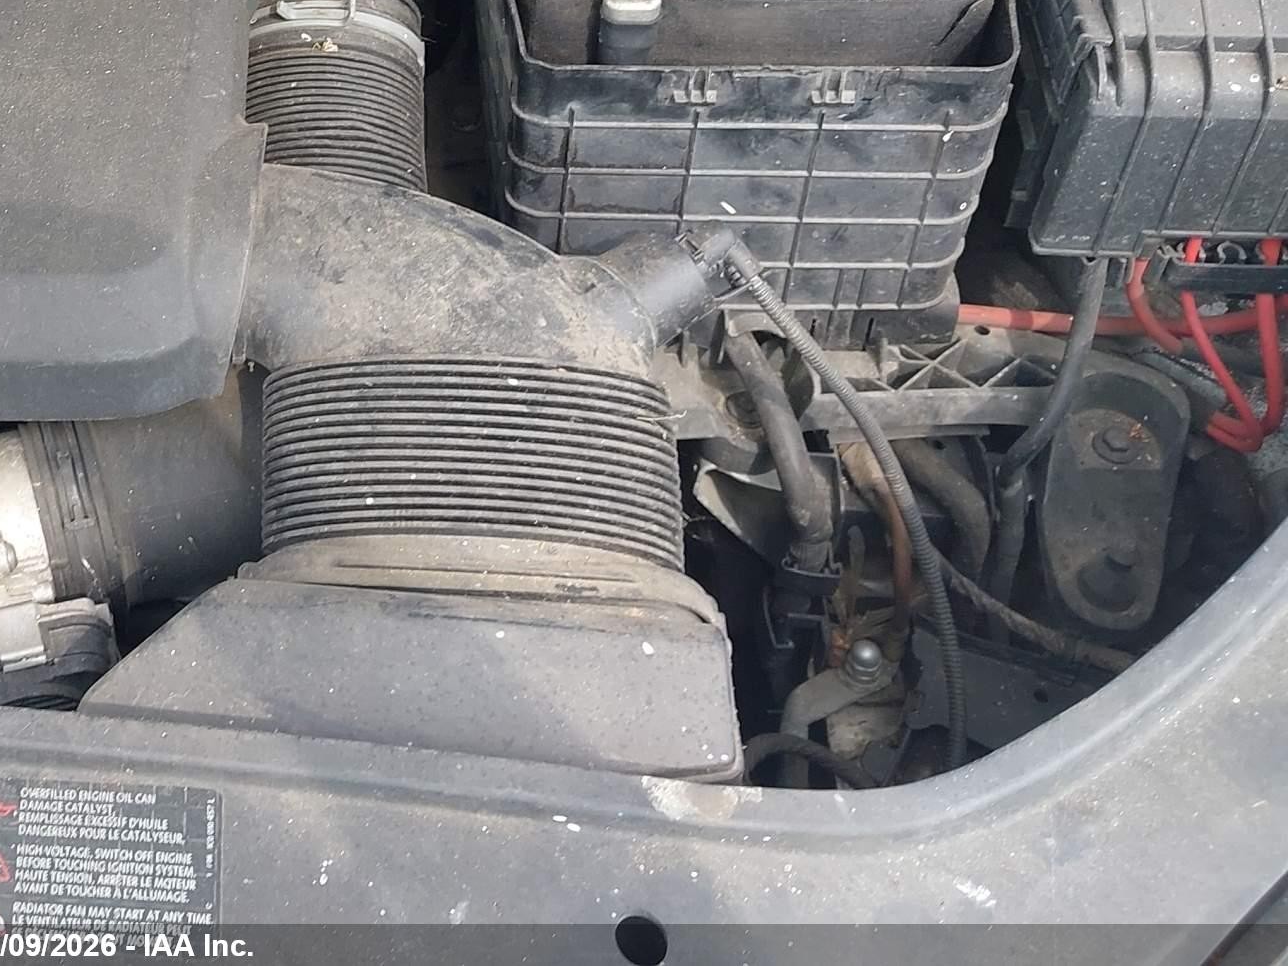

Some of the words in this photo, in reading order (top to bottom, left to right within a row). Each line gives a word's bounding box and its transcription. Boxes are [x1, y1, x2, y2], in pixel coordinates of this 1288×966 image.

[20, 787, 77, 800] OVERFILLED
[78, 790, 114, 803] ENGINE
[116, 792, 133, 804] OIL
[134, 792, 156, 805] CAN
[19, 799, 64, 812] DAMAGE
[18, 811, 83, 826] REMPLISSAGE
[84, 814, 128, 828] EXCESSIF
[17, 824, 78, 838] DANGEREUX
[79, 827, 107, 840] POUR
[108, 829, 121, 841] LE
[16, 843, 43, 857] HIGH
[94, 848, 133, 861] SWITCH
[134, 850, 154, 862] OFF
[155, 851, 192, 865] ENGINE
[16, 856, 52, 869] BEFORE
[53, 858, 106, 873] TOUCHING
[107, 861, 154, 875] IGNITION
[14, 869, 50, 882] HAUTE
[140, 876, 153, 888] LE
[154, 877, 197, 891] MOTEUR
[14, 881, 49, 894] AVANT
[50, 884, 64, 896] DE
[66, 885, 112, 898] TOUCHER
[12, 901, 64, 915] RADIATOR
[65, 904, 86, 917] FAN
[88, 906, 113, 918] MAY
[113, 907, 145, 920] START
[146, 909, 161, 921] AT
[162, 911, 185, 923] ANY
[12, 914, 25, 926] LE
[25, 915, 92, 932] VENTILATEUR
[93, 919, 107, 931] DE
[108, 921, 166, 935] RADIATEUR
